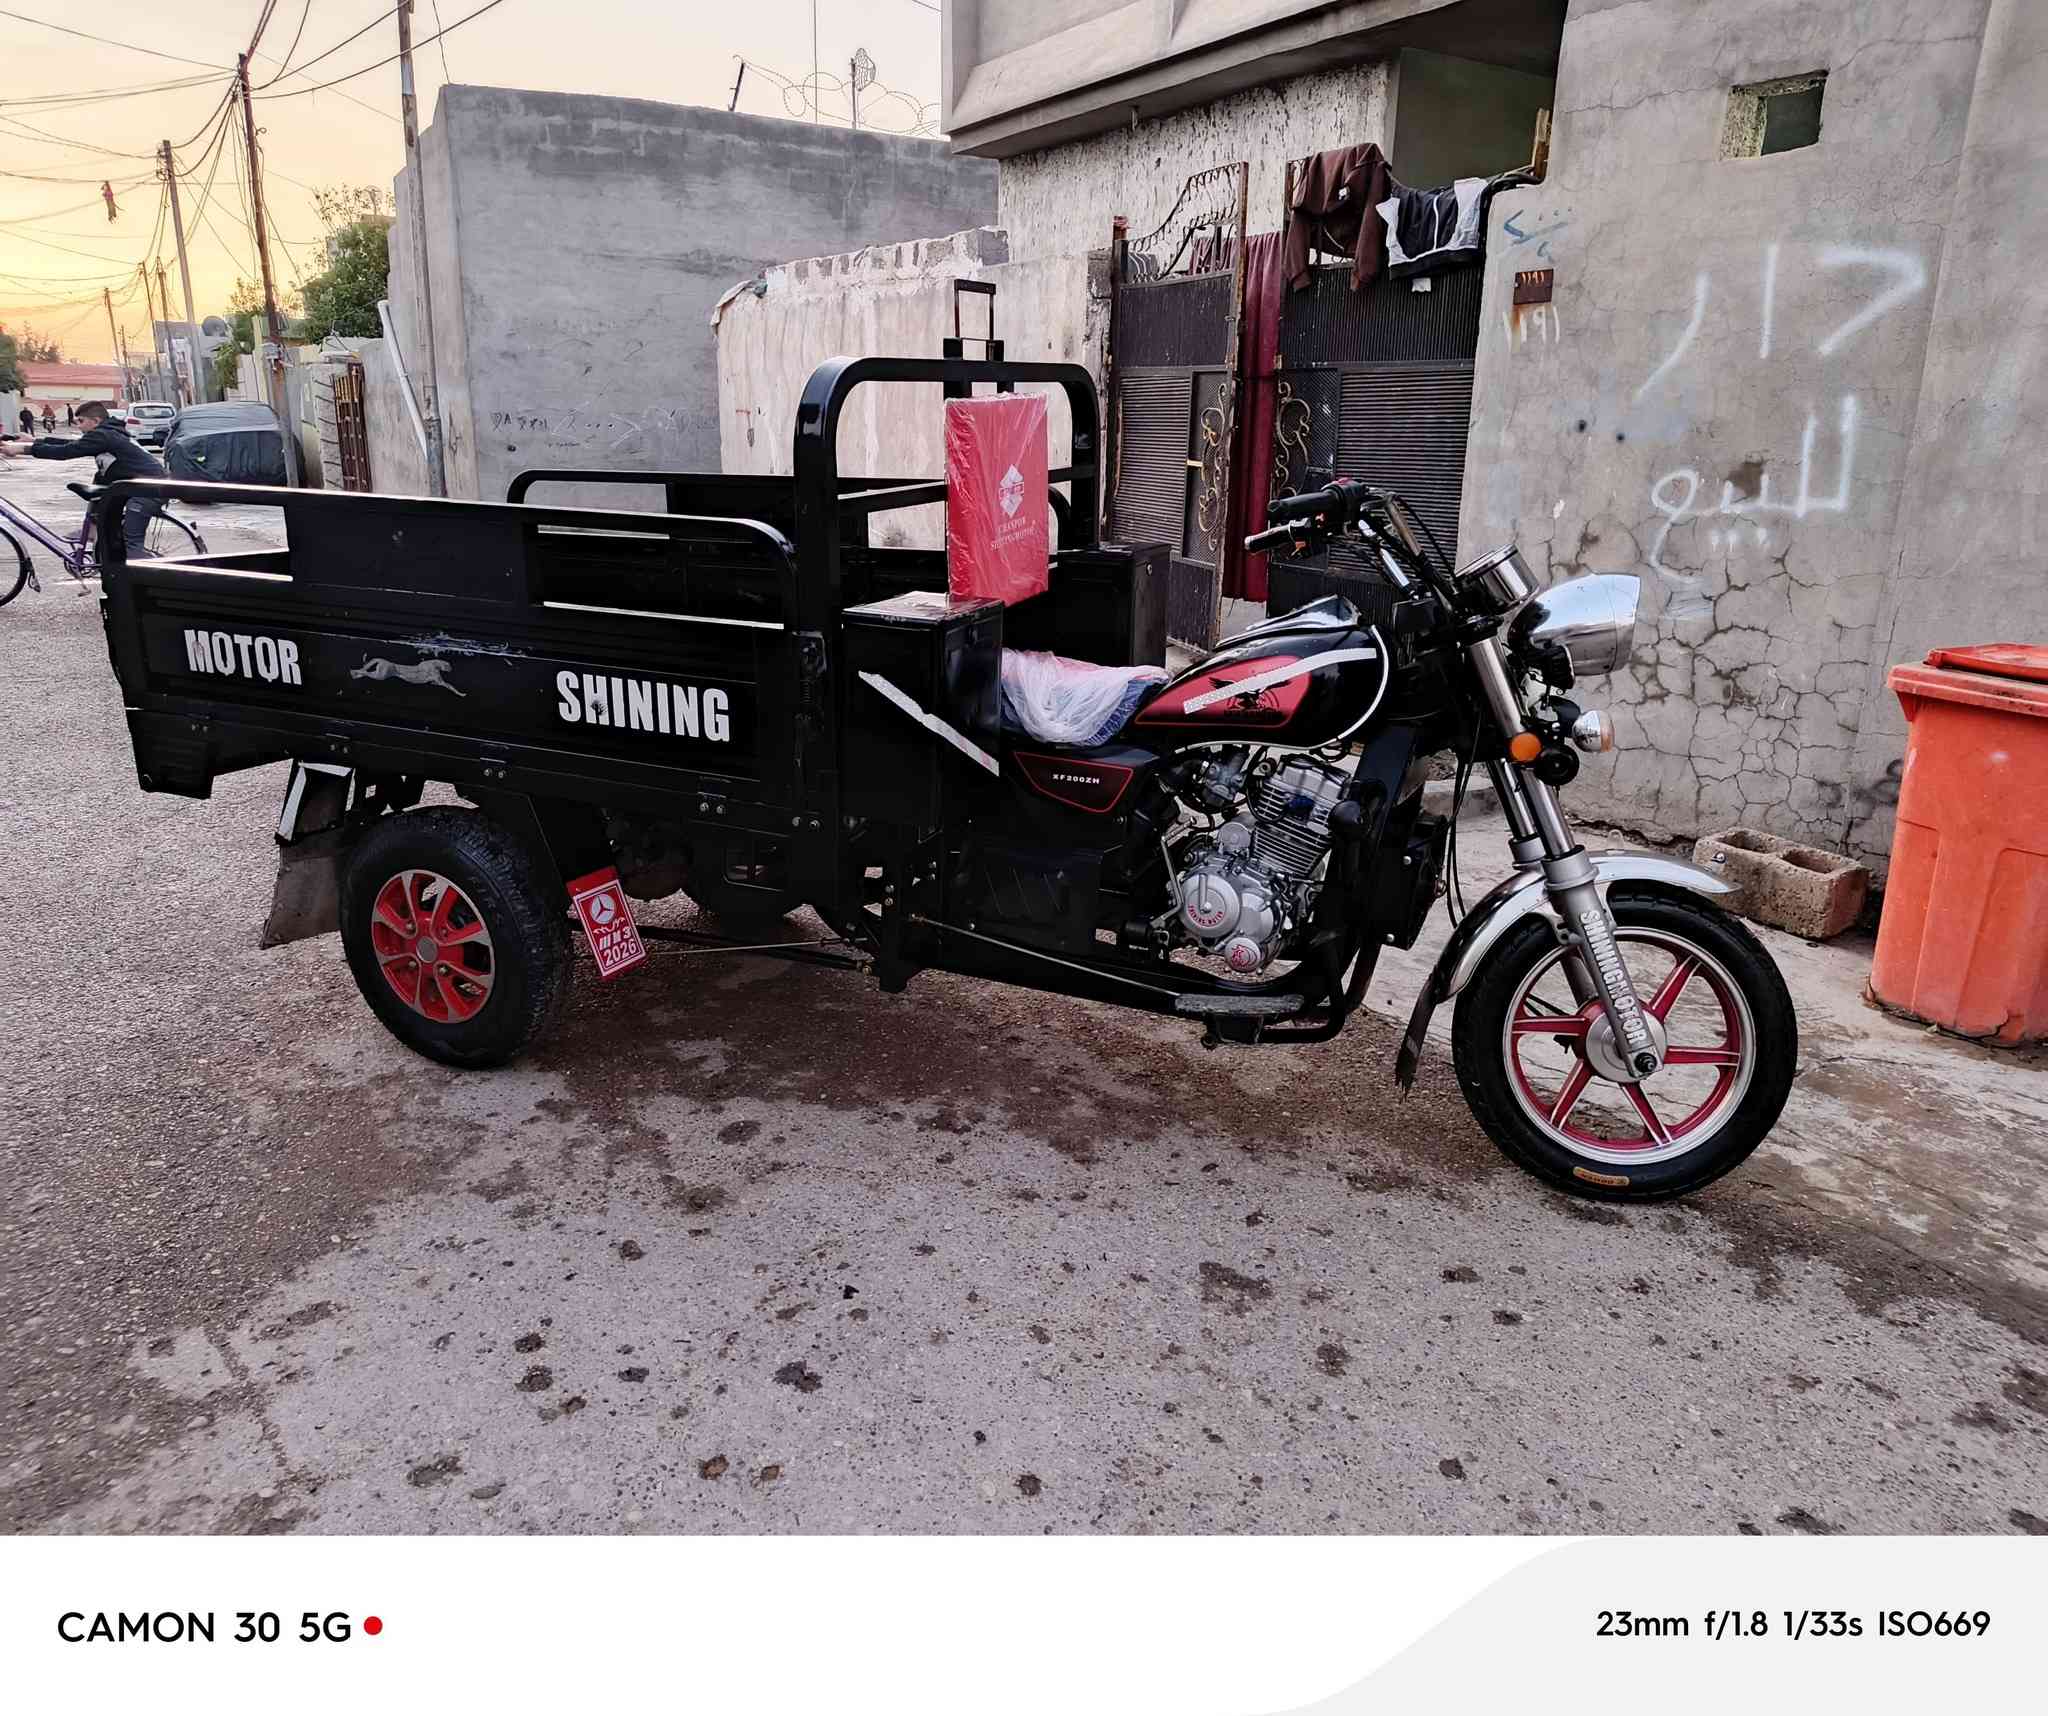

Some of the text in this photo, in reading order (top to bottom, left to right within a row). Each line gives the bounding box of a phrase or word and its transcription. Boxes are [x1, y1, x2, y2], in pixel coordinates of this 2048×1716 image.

[1635, 243, 1926, 398] دار
[1650, 394, 1858, 583] للبيع
[184, 629, 302, 685] MOTOR
[556, 670, 730, 742] SHINING
[605, 939, 637, 966] 2026
